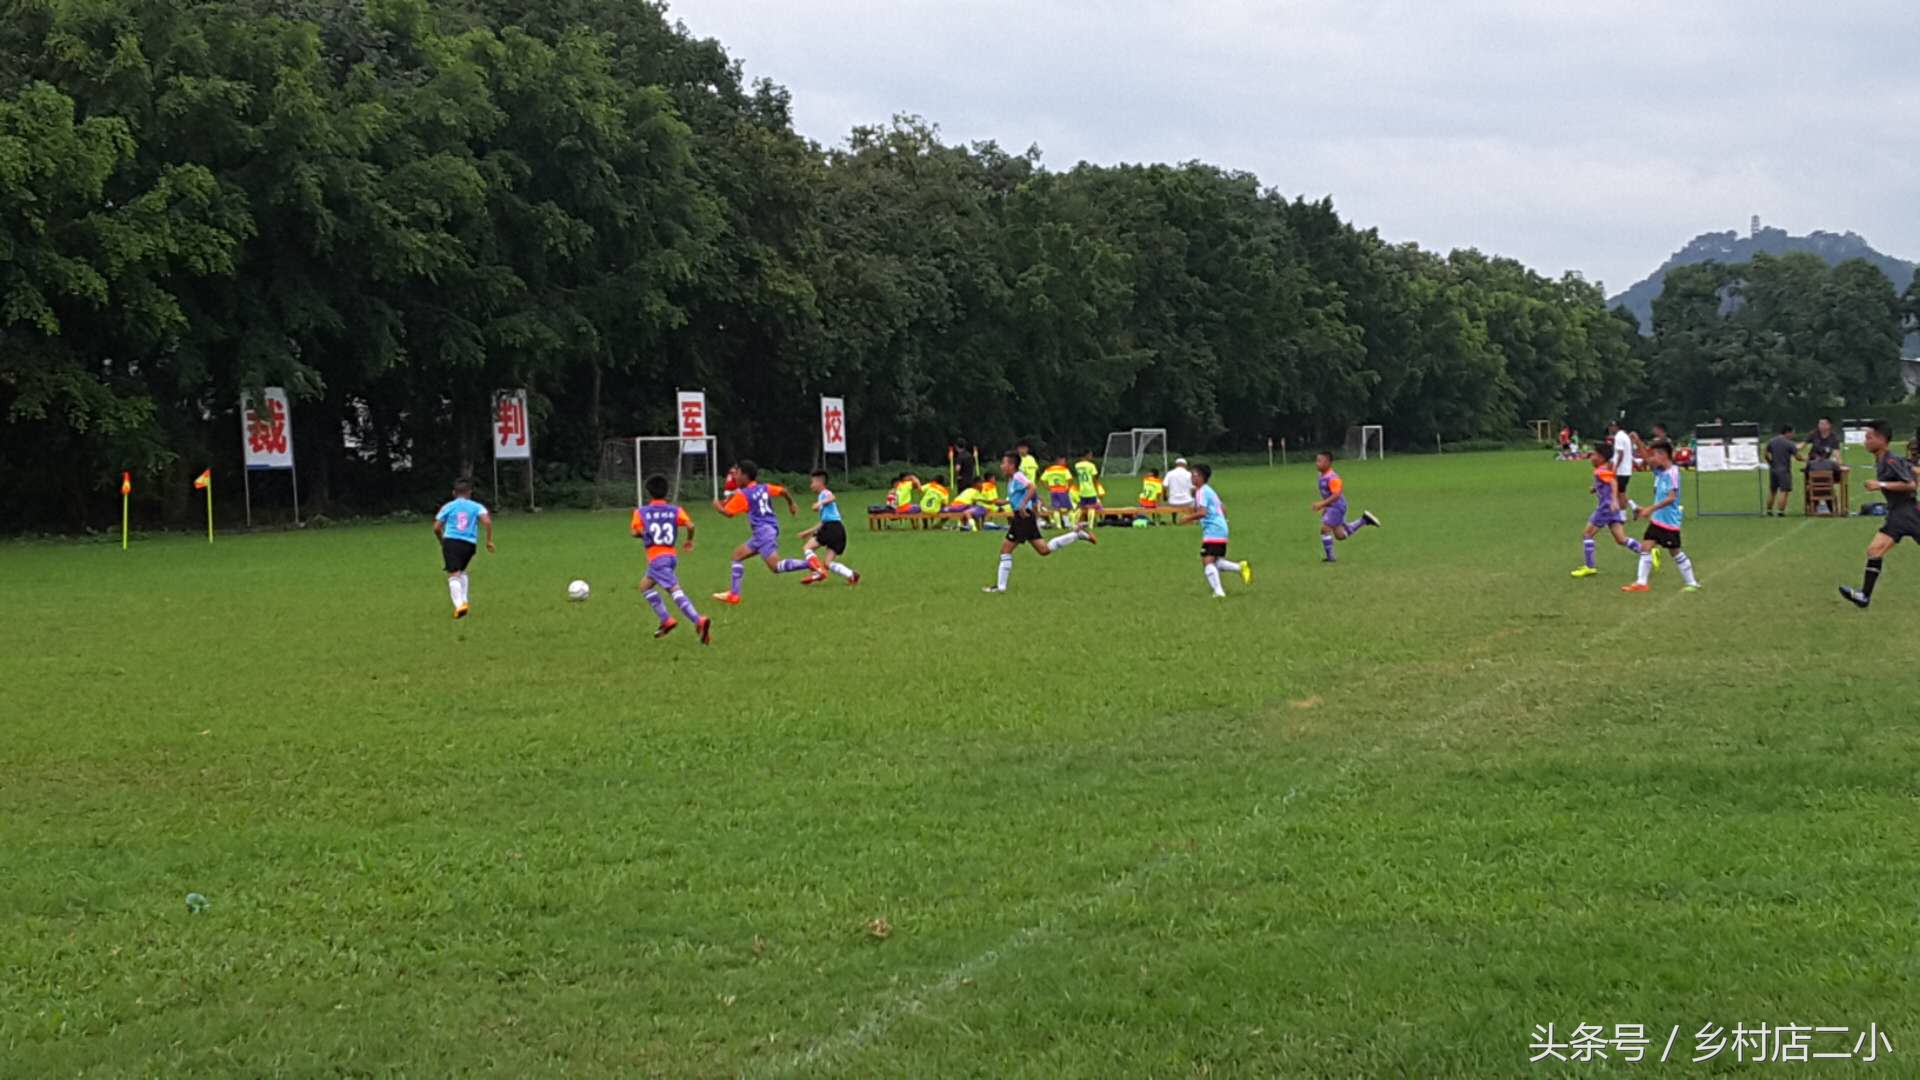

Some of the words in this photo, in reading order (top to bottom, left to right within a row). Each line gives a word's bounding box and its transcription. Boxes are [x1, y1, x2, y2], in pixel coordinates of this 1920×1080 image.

[497, 398, 525, 447] 判
[681, 402, 704, 442] 军
[825, 406, 842, 444] 校
[649, 522, 674, 545] 23
